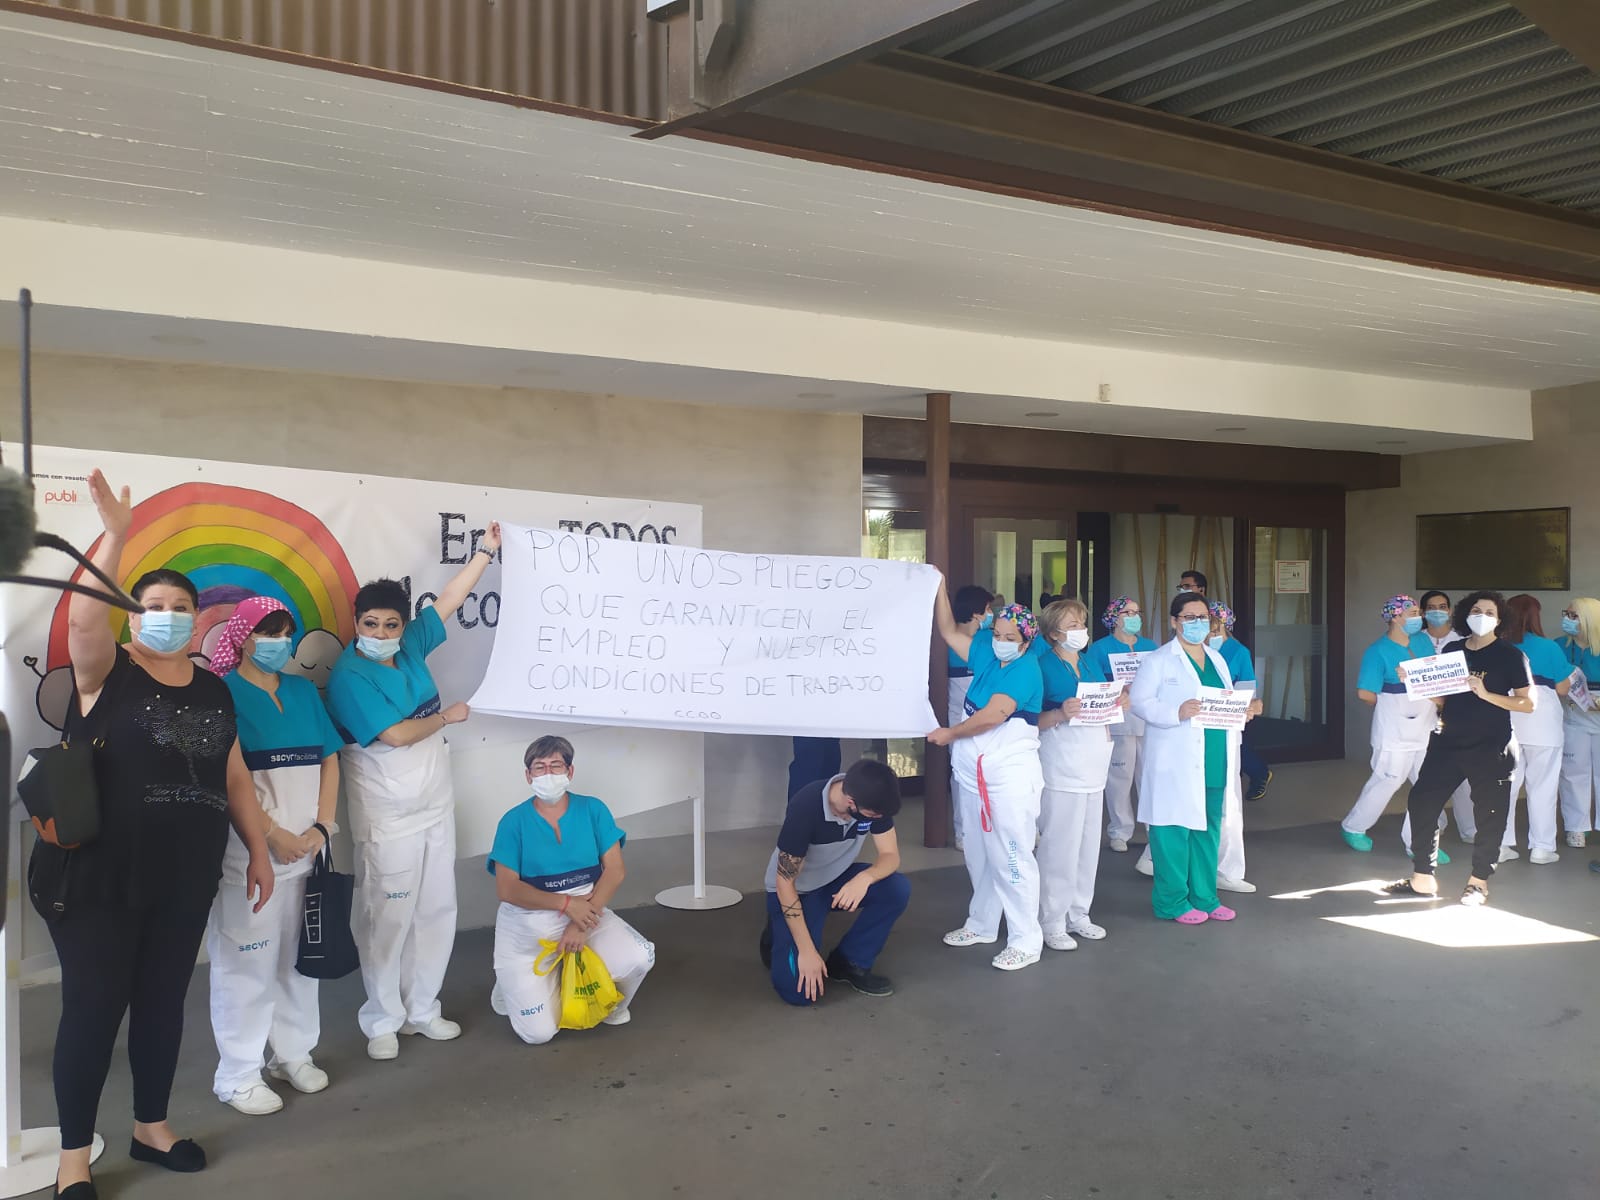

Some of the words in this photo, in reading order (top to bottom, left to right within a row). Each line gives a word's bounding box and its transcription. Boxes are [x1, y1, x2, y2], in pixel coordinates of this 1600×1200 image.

[525, 529, 600, 574] POR
[637, 545, 743, 589] UNOS
[755, 555, 880, 590] PLIEGOS
[541, 584, 624, 619] QUE
[640, 598, 813, 631] GARANTICEN
[843, 607, 874, 630] EL
[538, 626, 666, 661] EMPLEO
[718, 637, 735, 667] Y
[755, 635, 878, 660] NUESTRAS
[746, 676, 777, 696] DE
[786, 674, 884, 696] TRABAJO
[238, 939, 270, 952] sacyr
[519, 1002, 545, 1016] sacyr
